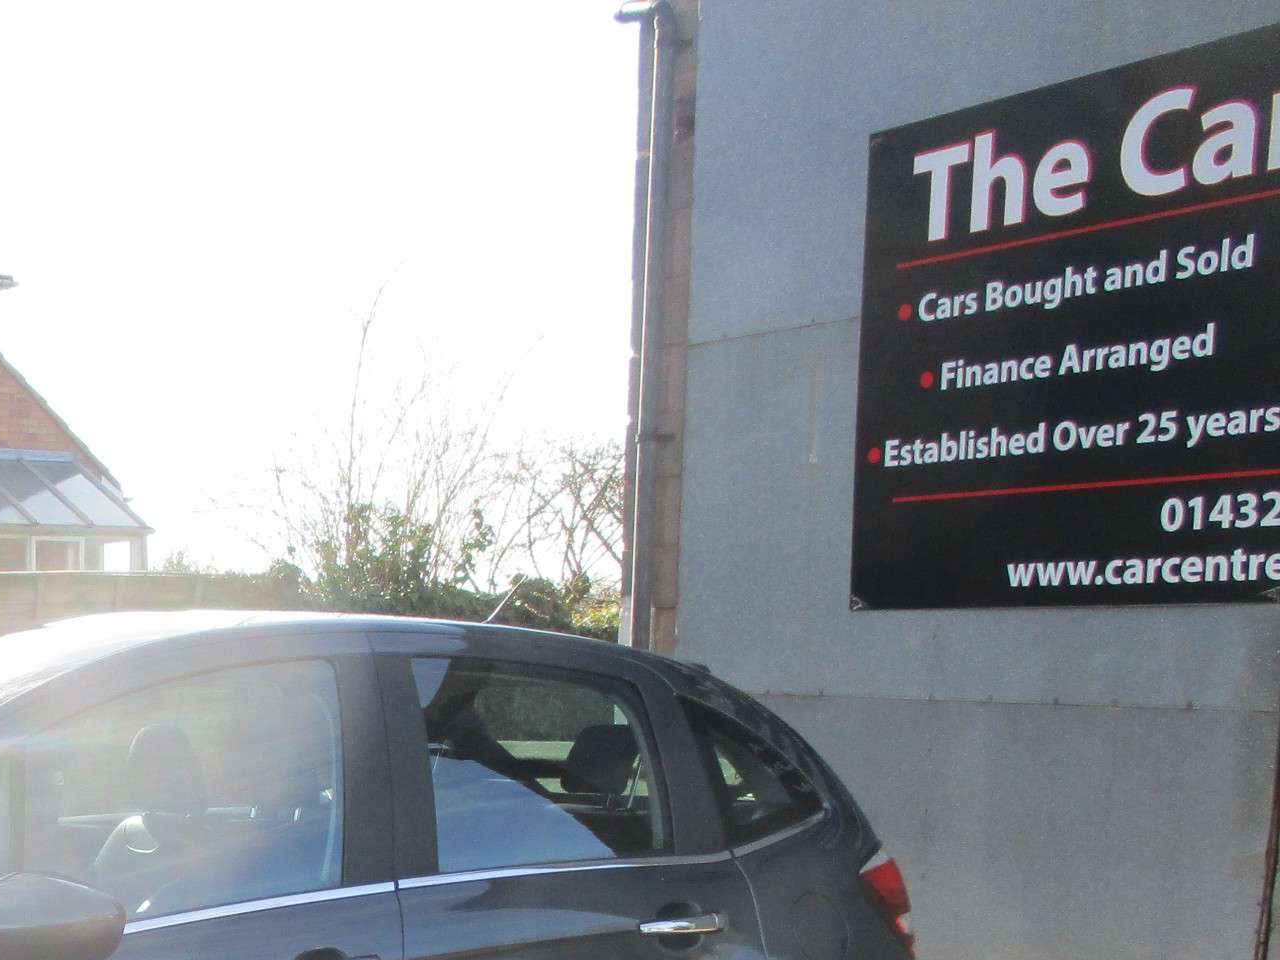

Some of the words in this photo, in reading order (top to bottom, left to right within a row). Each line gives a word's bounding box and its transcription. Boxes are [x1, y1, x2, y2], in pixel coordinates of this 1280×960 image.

[912, 131, 1090, 242] The
[918, 292, 978, 322] Cars
[985, 268, 1098, 312] Bought
[1104, 248, 1168, 292] and
[1175, 233, 1255, 280] Sold
[940, 355, 1052, 391] Finance
[1058, 322, 1215, 375] Arranged
[884, 422, 1046, 467] Established
[1053, 420, 1130, 451] Over
[1136, 410, 1178, 444] 25
[1186, 406, 1280, 448] years
[1160, 490, 1280, 532] 01432
[1007, 548, 1280, 587] www.carcentre
